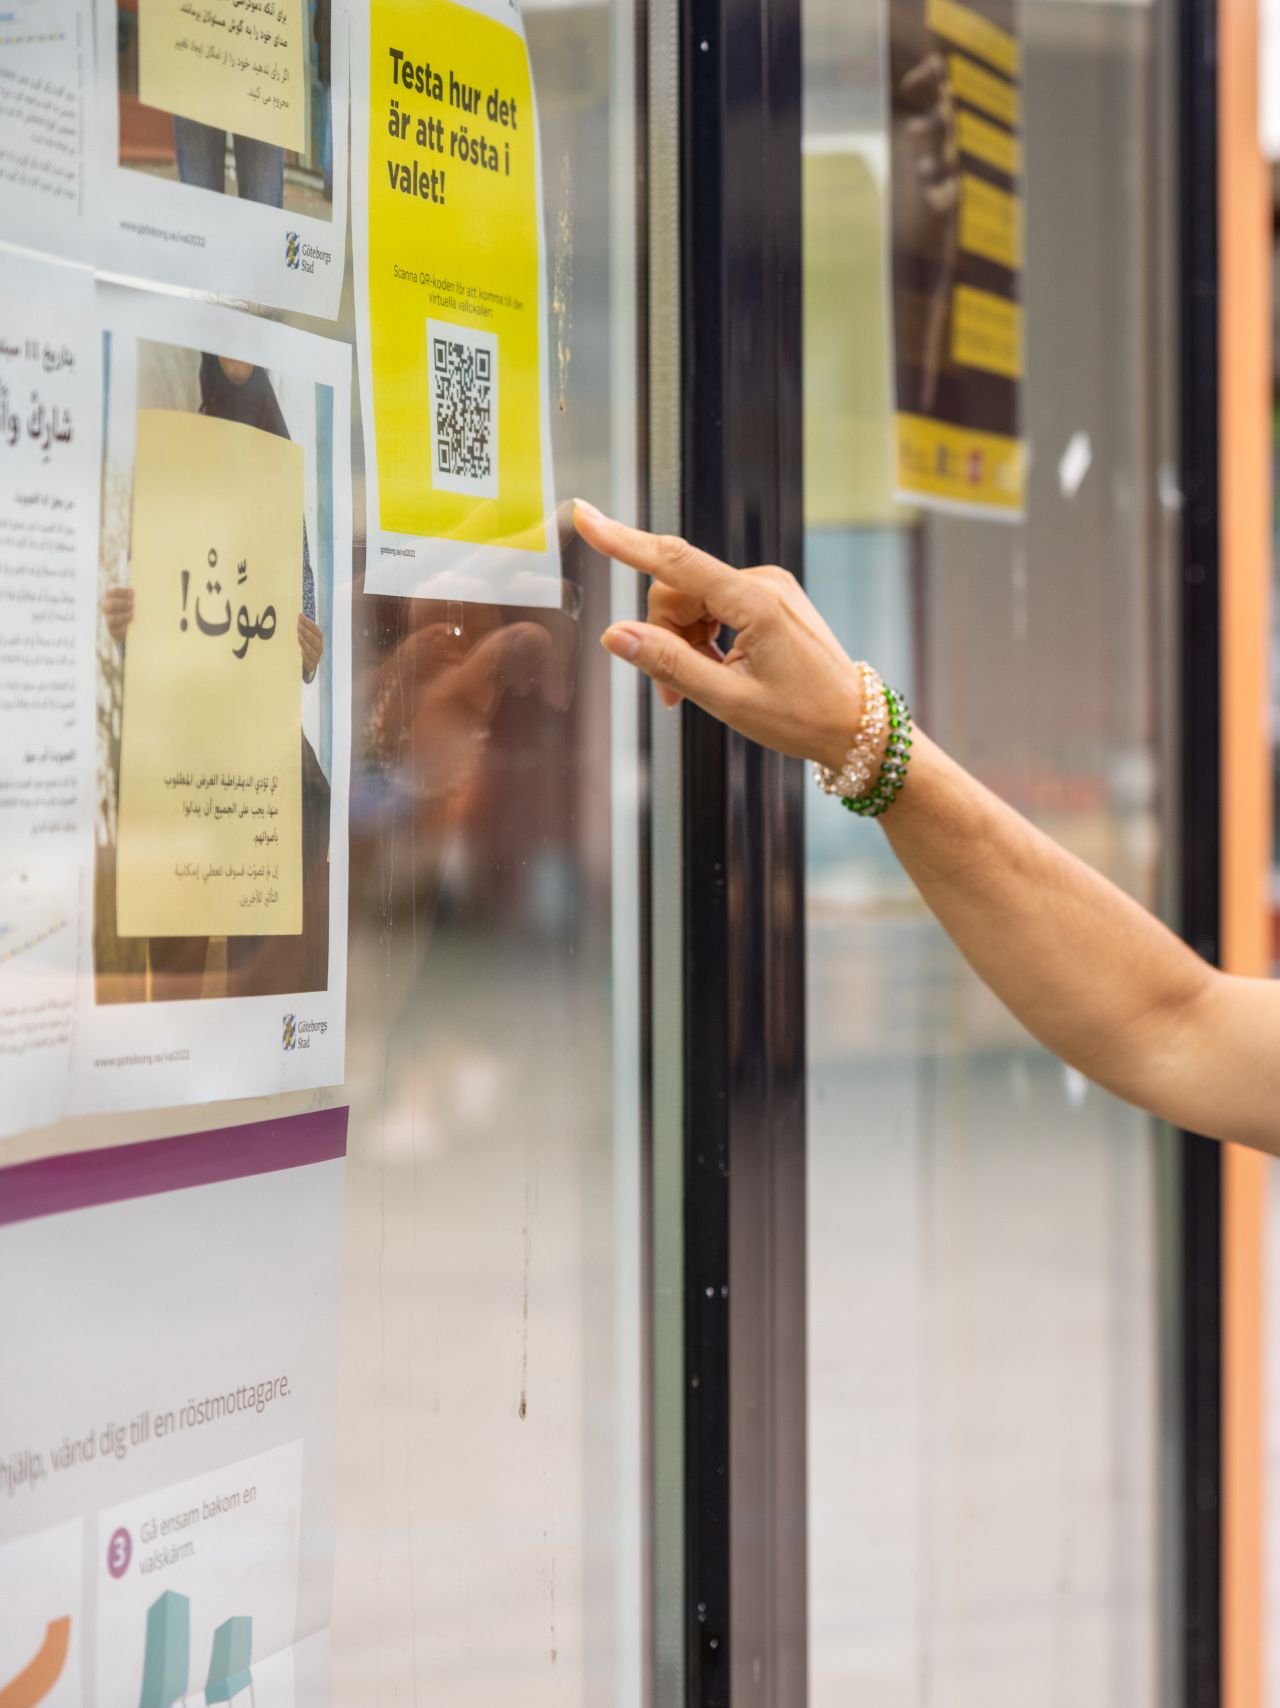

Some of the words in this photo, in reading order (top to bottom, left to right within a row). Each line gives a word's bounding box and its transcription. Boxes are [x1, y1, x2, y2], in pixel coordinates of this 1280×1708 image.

[389, 48, 443, 102] Testa
[450, 71, 481, 116] hur
[487, 89, 517, 130] det
[388, 100, 411, 141] är
[415, 117, 445, 154] att
[450, 126, 499, 172] rösta
[504, 142, 510, 176] i
[387, 160, 445, 205] valet!
[302, 243, 332, 266] Göteborgs
[302, 260, 314, 274] Stad
[393, 264, 418, 283] Scanna
[419, 271, 455, 292] QR-koden
[456, 281, 466, 296] för
[466, 287, 477, 298] att
[478, 287, 504, 305] komma
[428, 293, 457, 310] virtuella
[298, 1020, 327, 1035] Göteborgs
[298, 1036, 310, 1049] Stad
[49, 1428, 96, 1472] vänd
[100, 1423, 127, 1460] dig
[130, 1413, 150, 1447] till
[154, 1410, 175, 1438] en
[179, 1374, 292, 1428] röstmottagare.
[140, 1521, 158, 1544] Gå
[160, 1508, 199, 1538] ensam
[203, 1494, 240, 1523] bakom
[243, 1485, 257, 1504] en
[114, 1538, 126, 1568] 3
[139, 1538, 197, 1576] valskärm.
